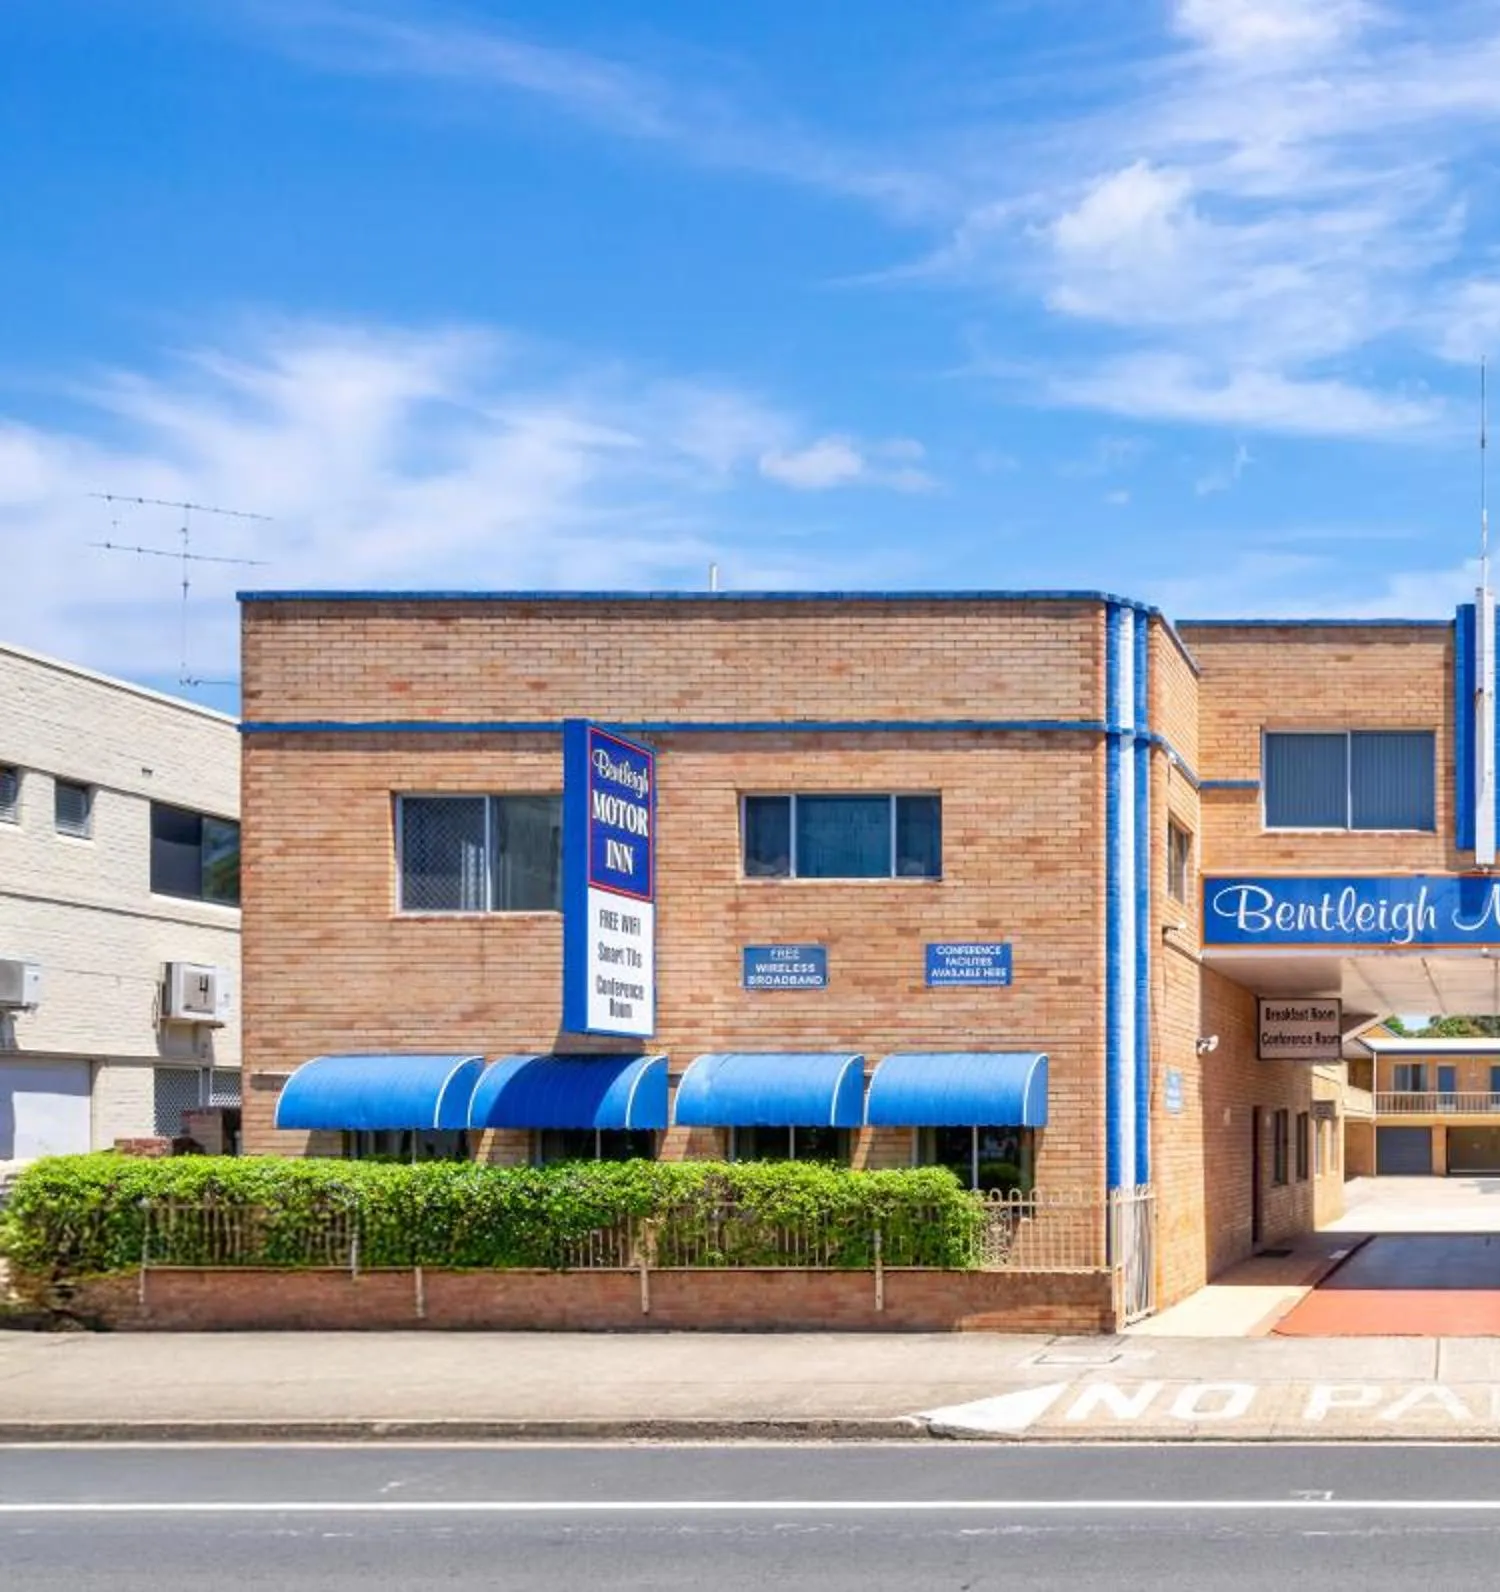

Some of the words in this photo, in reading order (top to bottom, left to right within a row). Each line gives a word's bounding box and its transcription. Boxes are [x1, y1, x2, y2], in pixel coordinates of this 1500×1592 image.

[592, 748, 649, 799] Bentleigh
[592, 789, 649, 837] MOTOR
[606, 838, 634, 875] INN
[599, 908, 619, 932] FREE
[1213, 885, 1436, 944] Bentleigh
[598, 941, 624, 965] Smart
[769, 949, 800, 960] FREE
[935, 945, 1002, 955] CONFERENCE
[755, 963, 816, 973] WIRELESS
[931, 967, 981, 977] AVAILABLE
[982, 967, 1007, 977] HERE
[945, 957, 993, 967] FACILITIES
[596, 974, 644, 1001] Conference
[747, 975, 823, 985] BROADBAND
[609, 998, 632, 1018] Room
[1265, 1007, 1308, 1021] Breakfast
[1311, 1007, 1336, 1021] Room
[1261, 1031, 1313, 1045] Conference
[1315, 1031, 1341, 1045] Room
[1065, 1381, 1257, 1421] NO
